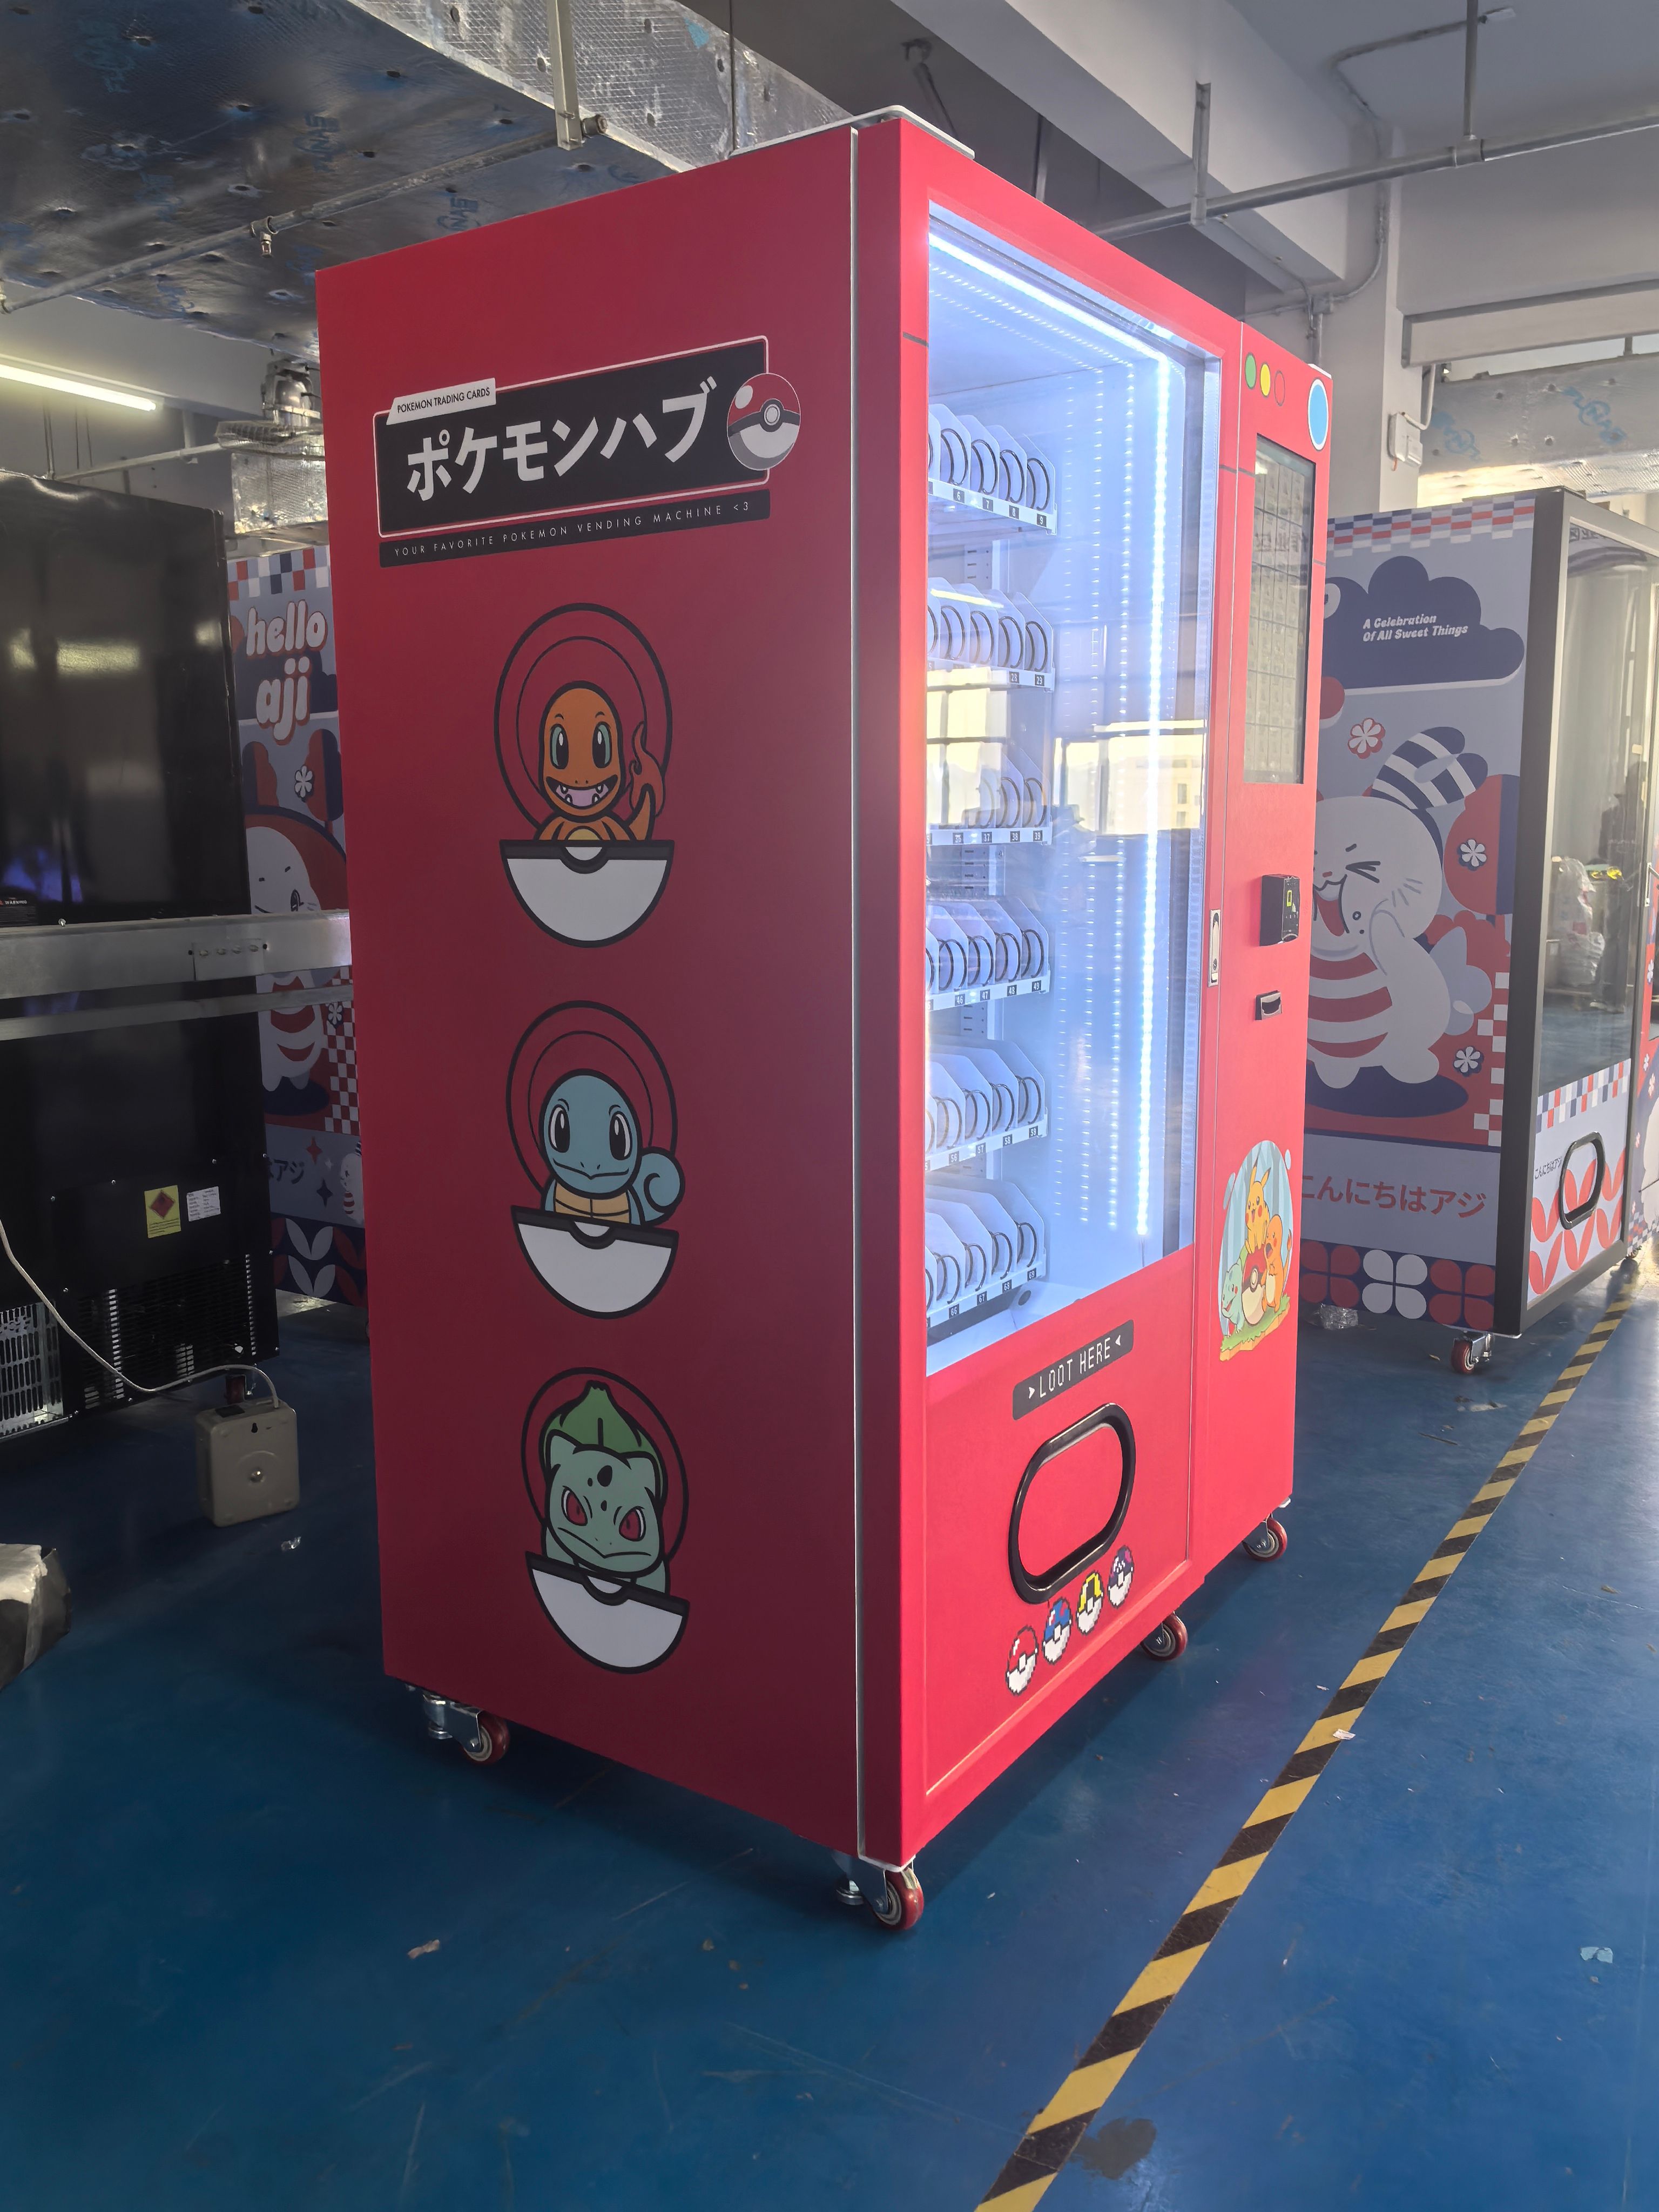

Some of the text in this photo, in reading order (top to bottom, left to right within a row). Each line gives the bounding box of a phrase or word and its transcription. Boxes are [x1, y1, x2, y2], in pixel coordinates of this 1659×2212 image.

[397, 387, 490, 414] POKEMON TRADING CARDS
[407, 376, 717, 501] ポケモンハブ
[1011, 508, 1016, 517] 8
[1039, 516, 1043, 524] 9
[395, 545, 424, 557] YOUR
[434, 536, 493, 552] FAVORITE
[503, 526, 567, 543] POKEMON
[577, 516, 642, 533] VENDING
[653, 505, 721, 523] MACHINE
[246, 599, 326, 657] hello
[1363, 613, 1437, 629] A Celebration
[1363, 624, 1469, 642] Of All Sweet Things
[1036, 676, 1043, 684] 29
[255, 656, 310, 741] aji
[983, 833, 990, 841] 37
[1012, 833, 1018, 841] 38
[1035, 832, 1041, 840] 39
[956, 996, 963, 1004] 46
[982, 991, 988, 1000] 47
[1009, 986, 1015, 995] 48
[1033, 982, 1040, 990] 49
[950, 1153, 957, 1162] 56
[977, 1145, 984, 1154] 57
[1004, 1136, 1010, 1144] 58
[1302, 1175, 1487, 1218] こんにちはアジ
[950, 1270, 1035, 1316] 66 67 68 69
[1040, 1337, 1111, 1398] LOOT HERE
